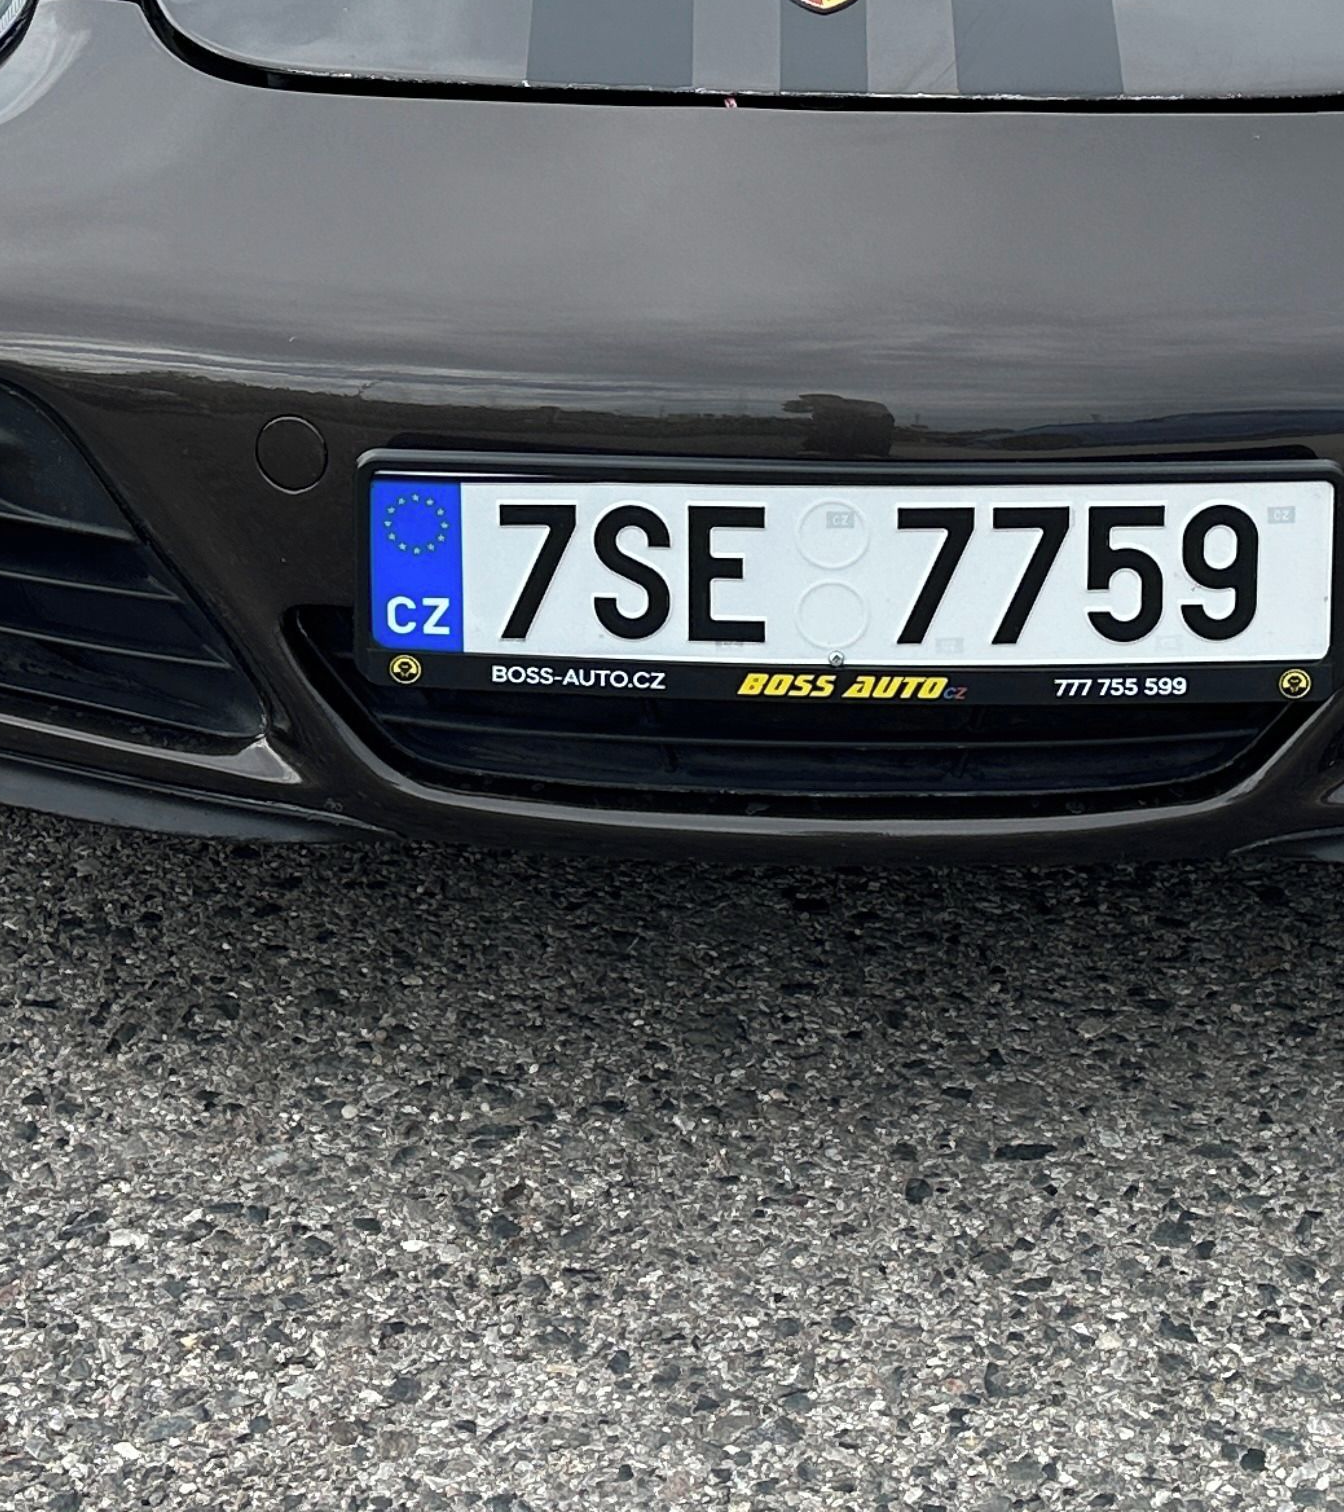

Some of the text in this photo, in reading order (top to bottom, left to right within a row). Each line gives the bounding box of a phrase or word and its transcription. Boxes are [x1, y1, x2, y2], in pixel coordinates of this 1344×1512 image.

[499, 503, 1260, 646] 7SE 7759
[386, 595, 451, 635] CZ
[491, 664, 667, 690] BOSS-AUTO.CZ
[736, 672, 838, 698] BOSS
[840, 674, 950, 700] AUTO
[1054, 675, 1189, 698] 777 755 599
